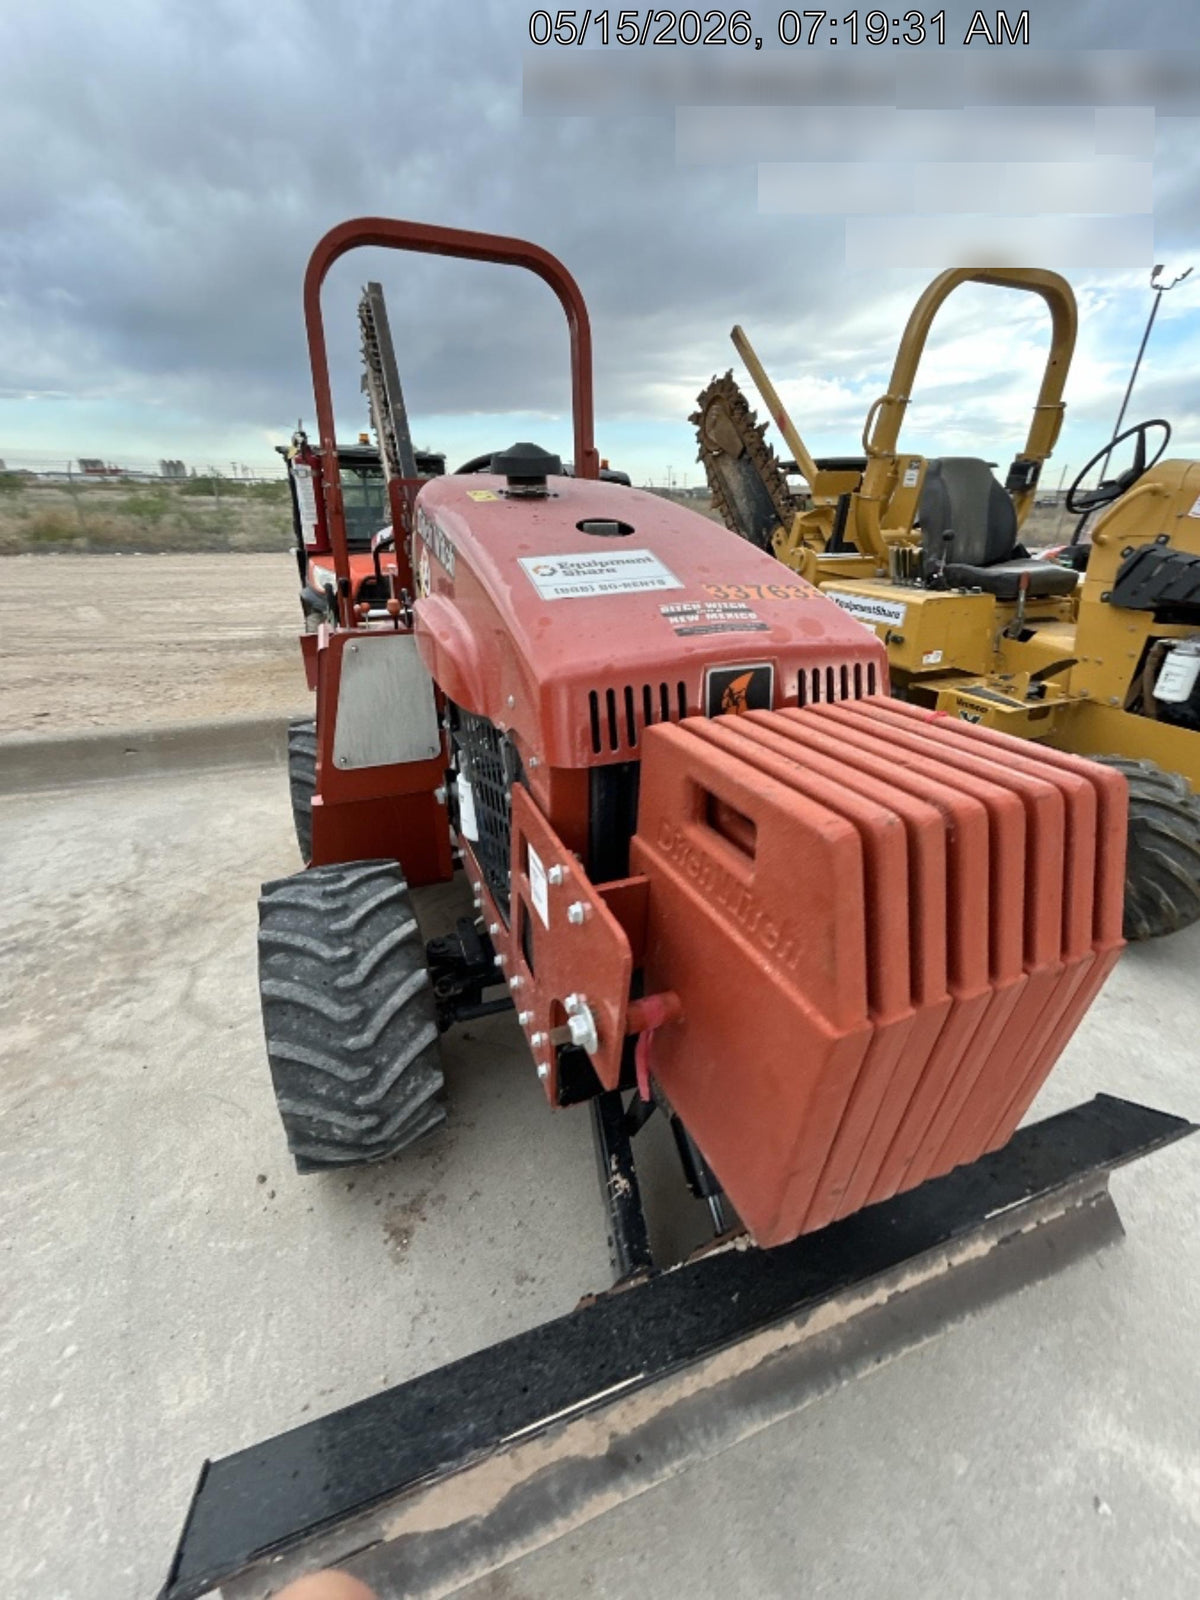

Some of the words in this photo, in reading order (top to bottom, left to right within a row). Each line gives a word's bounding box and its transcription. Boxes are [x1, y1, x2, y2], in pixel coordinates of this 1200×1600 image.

[557, 556, 654, 569] Equipment
[562, 567, 617, 577] Share
[660, 602, 701, 614] DITCH
[704, 601, 748, 610] WITCH
[668, 613, 700, 624] NEW
[706, 611, 758, 621] MEXICO
